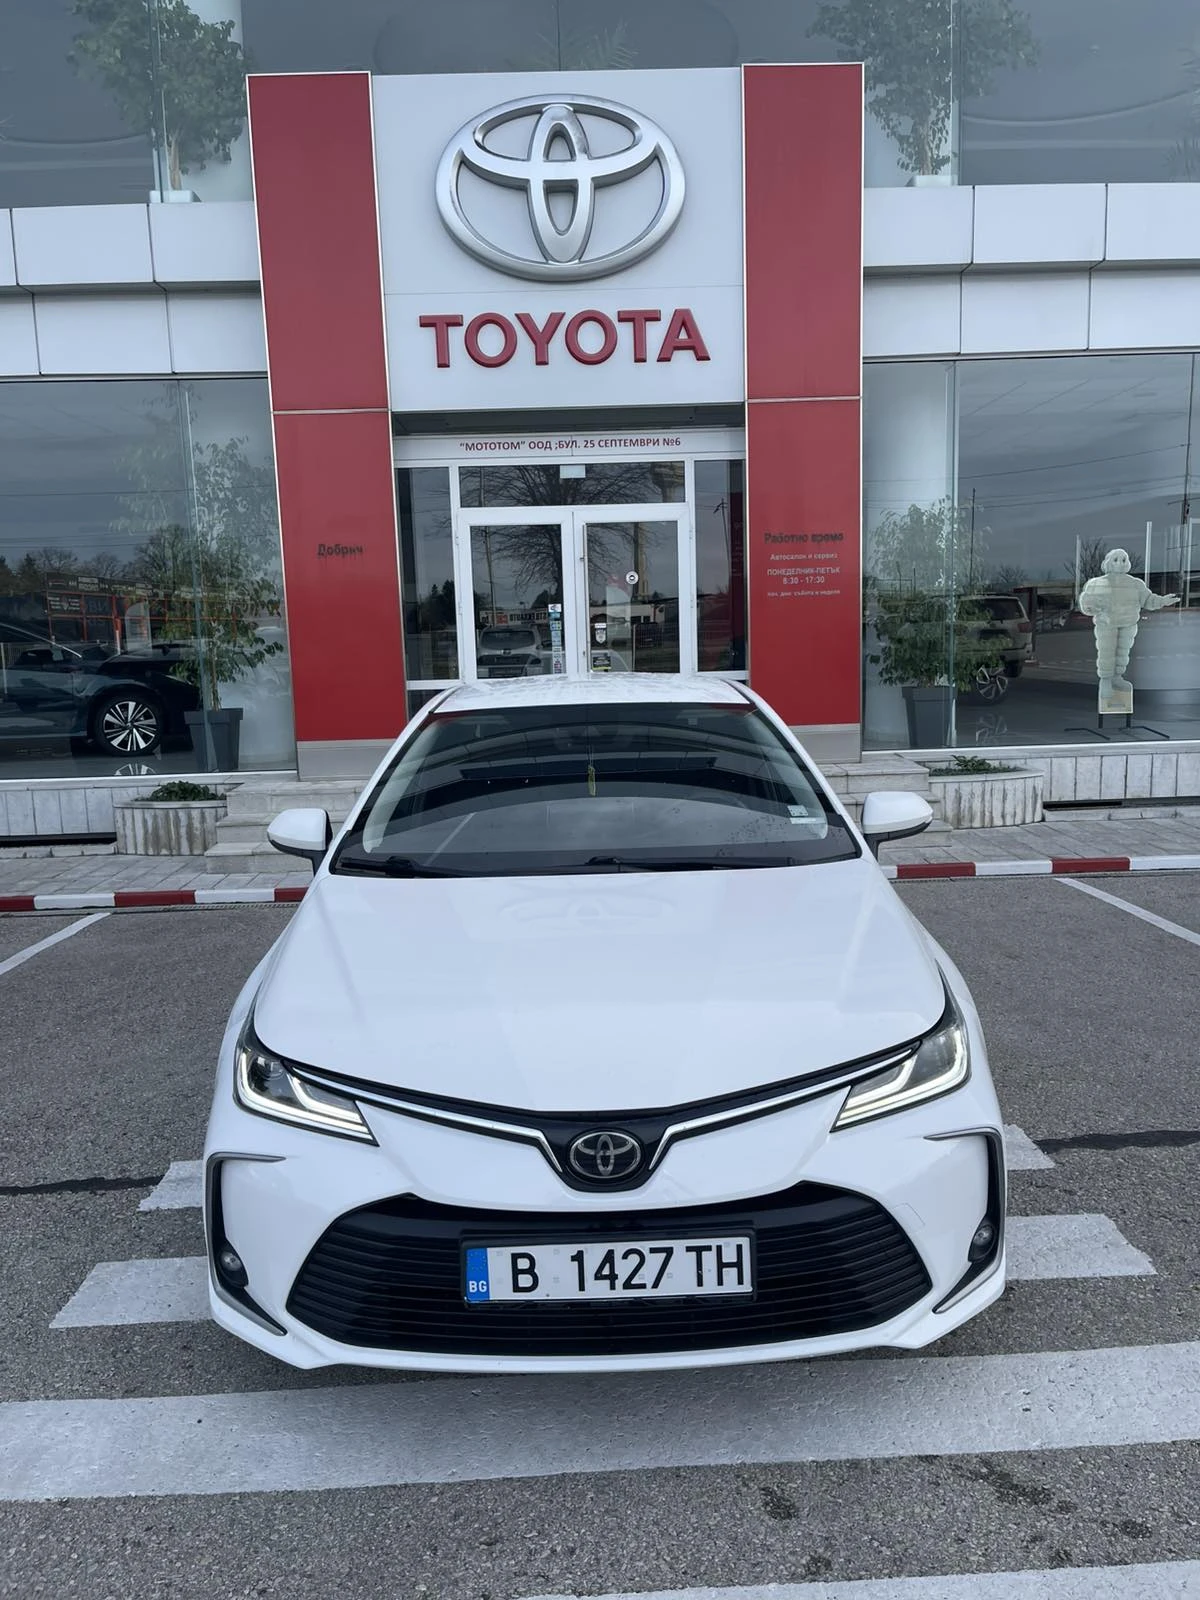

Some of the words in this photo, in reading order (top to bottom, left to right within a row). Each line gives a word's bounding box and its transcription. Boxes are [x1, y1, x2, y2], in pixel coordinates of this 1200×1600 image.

[419, 308, 711, 369] TOYOTA
[528, 440, 552, 451] ООД
[583, 440, 595, 448] 25
[597, 438, 660, 448] СЕПТЕМВРИ
[662, 437, 681, 447] №6
[317, 543, 363, 559] Добрич
[783, 576, 799, 584] 8:30
[805, 576, 825, 584] 17:30
[511, 1252, 540, 1293] B
[570, 1246, 674, 1292] 1427
[686, 1244, 744, 1288] TH
[469, 1280, 487, 1293] BG
